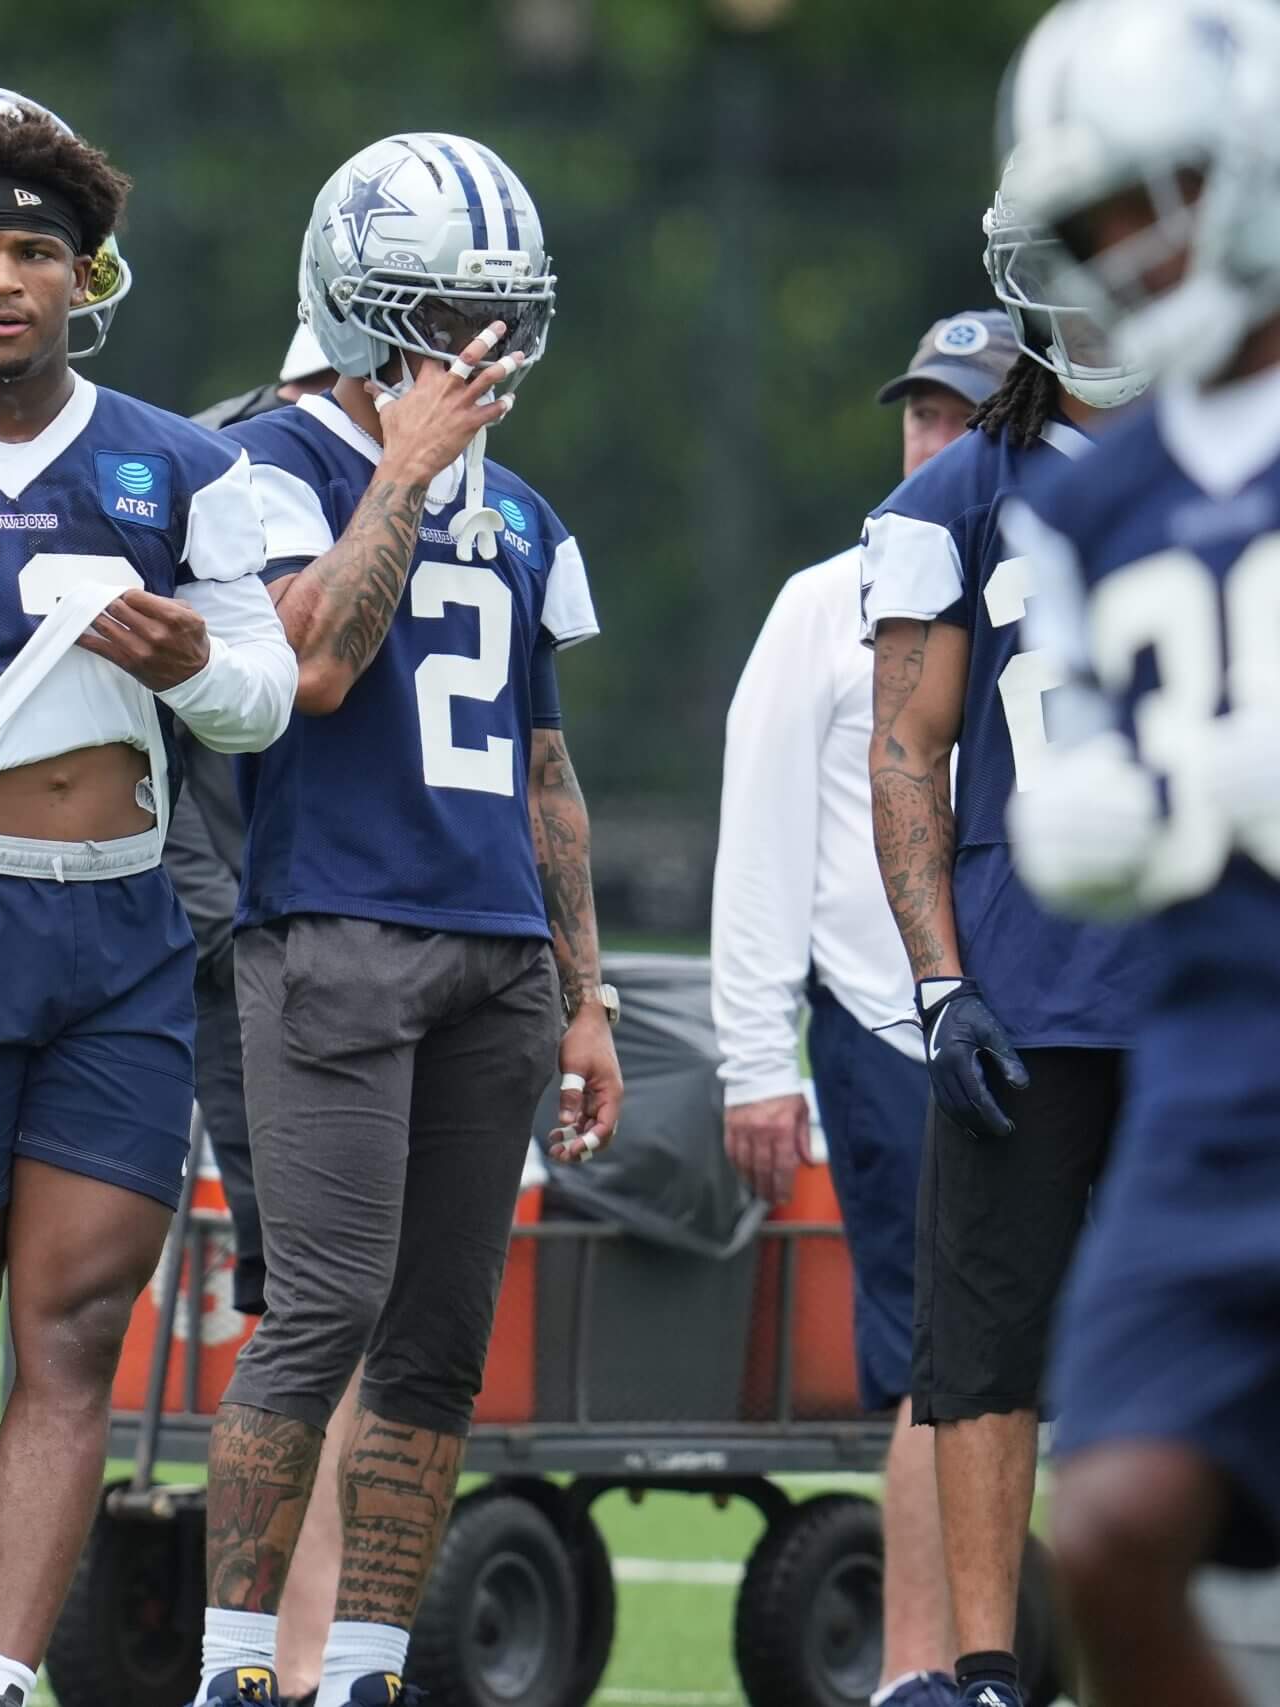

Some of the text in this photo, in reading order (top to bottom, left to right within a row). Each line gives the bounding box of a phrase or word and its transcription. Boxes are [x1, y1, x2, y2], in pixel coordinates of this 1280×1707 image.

[115, 496, 160, 519] AT&T
[503, 529, 532, 556] AT&T
[411, 560, 514, 797] 2
